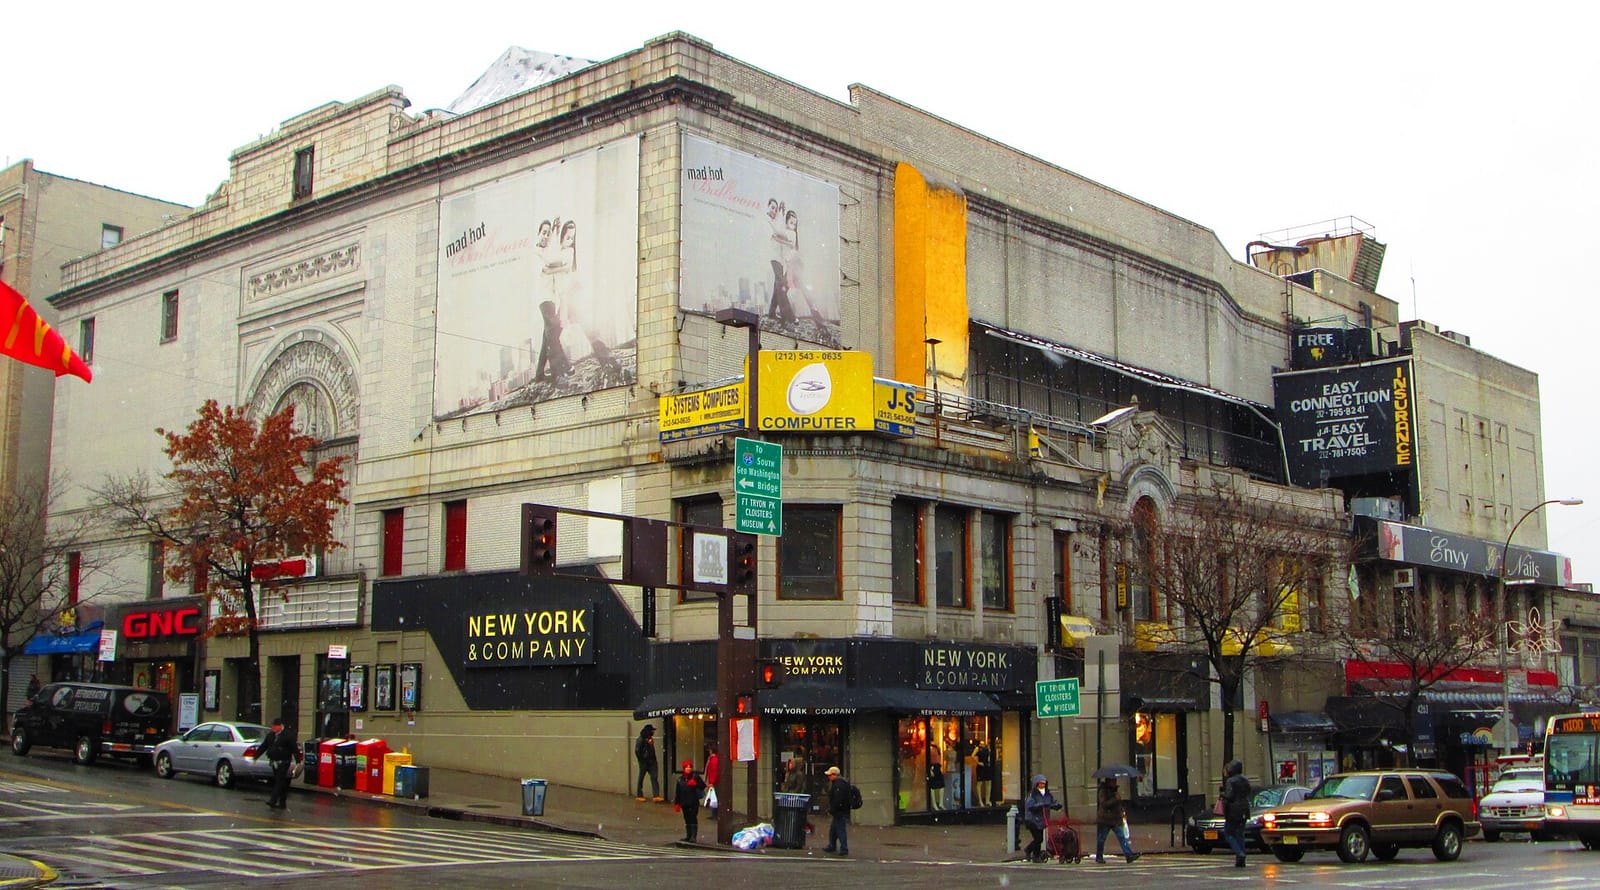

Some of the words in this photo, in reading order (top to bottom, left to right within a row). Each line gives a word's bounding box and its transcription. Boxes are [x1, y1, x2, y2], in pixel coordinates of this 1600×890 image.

[687, 166, 707, 180] mad
[708, 166, 724, 180] hot
[446, 231, 467, 258] mad
[469, 221, 486, 245] hot
[1298, 333, 1334, 347] FREE
[775, 352, 796, 360] (212)
[799, 352, 814, 360] 543
[821, 352, 842, 360] 0635
[1323, 381, 1359, 396] EASY
[703, 387, 739, 411] COMPUTERS
[1291, 389, 1391, 413] CONNECTION
[1393, 366, 1411, 465] INSURANCE
[762, 416, 856, 430] COMPUTER
[1332, 422, 1365, 436] EASY
[1299, 433, 1377, 452] TRAVEL
[736, 466, 748, 475] Geo
[748, 468, 780, 480] Washington
[757, 481, 779, 494] Bridge
[741, 498, 748, 506] FT
[750, 499, 766, 509] TRYON
[768, 502, 776, 510] PK
[745, 508, 773, 519] CLOISTERS
[741, 520, 764, 530] MUSEUM
[1430, 536, 1469, 569] Envy
[1507, 552, 1540, 579] Nails
[123, 608, 198, 638] GNC
[469, 614, 517, 638] NEW
[524, 609, 586, 635] YORK
[808, 656, 843, 666] YORK
[924, 649, 962, 667] NEW
[966, 650, 1008, 669] YORK
[1039, 685, 1047, 693] FT
[1049, 684, 1066, 692] TRYON
[1068, 682, 1076, 690] PK
[1045, 693, 1072, 702] CLOISTERS
[661, 708, 676, 716] YORK
[1054, 703, 1076, 712] MUSEUM
